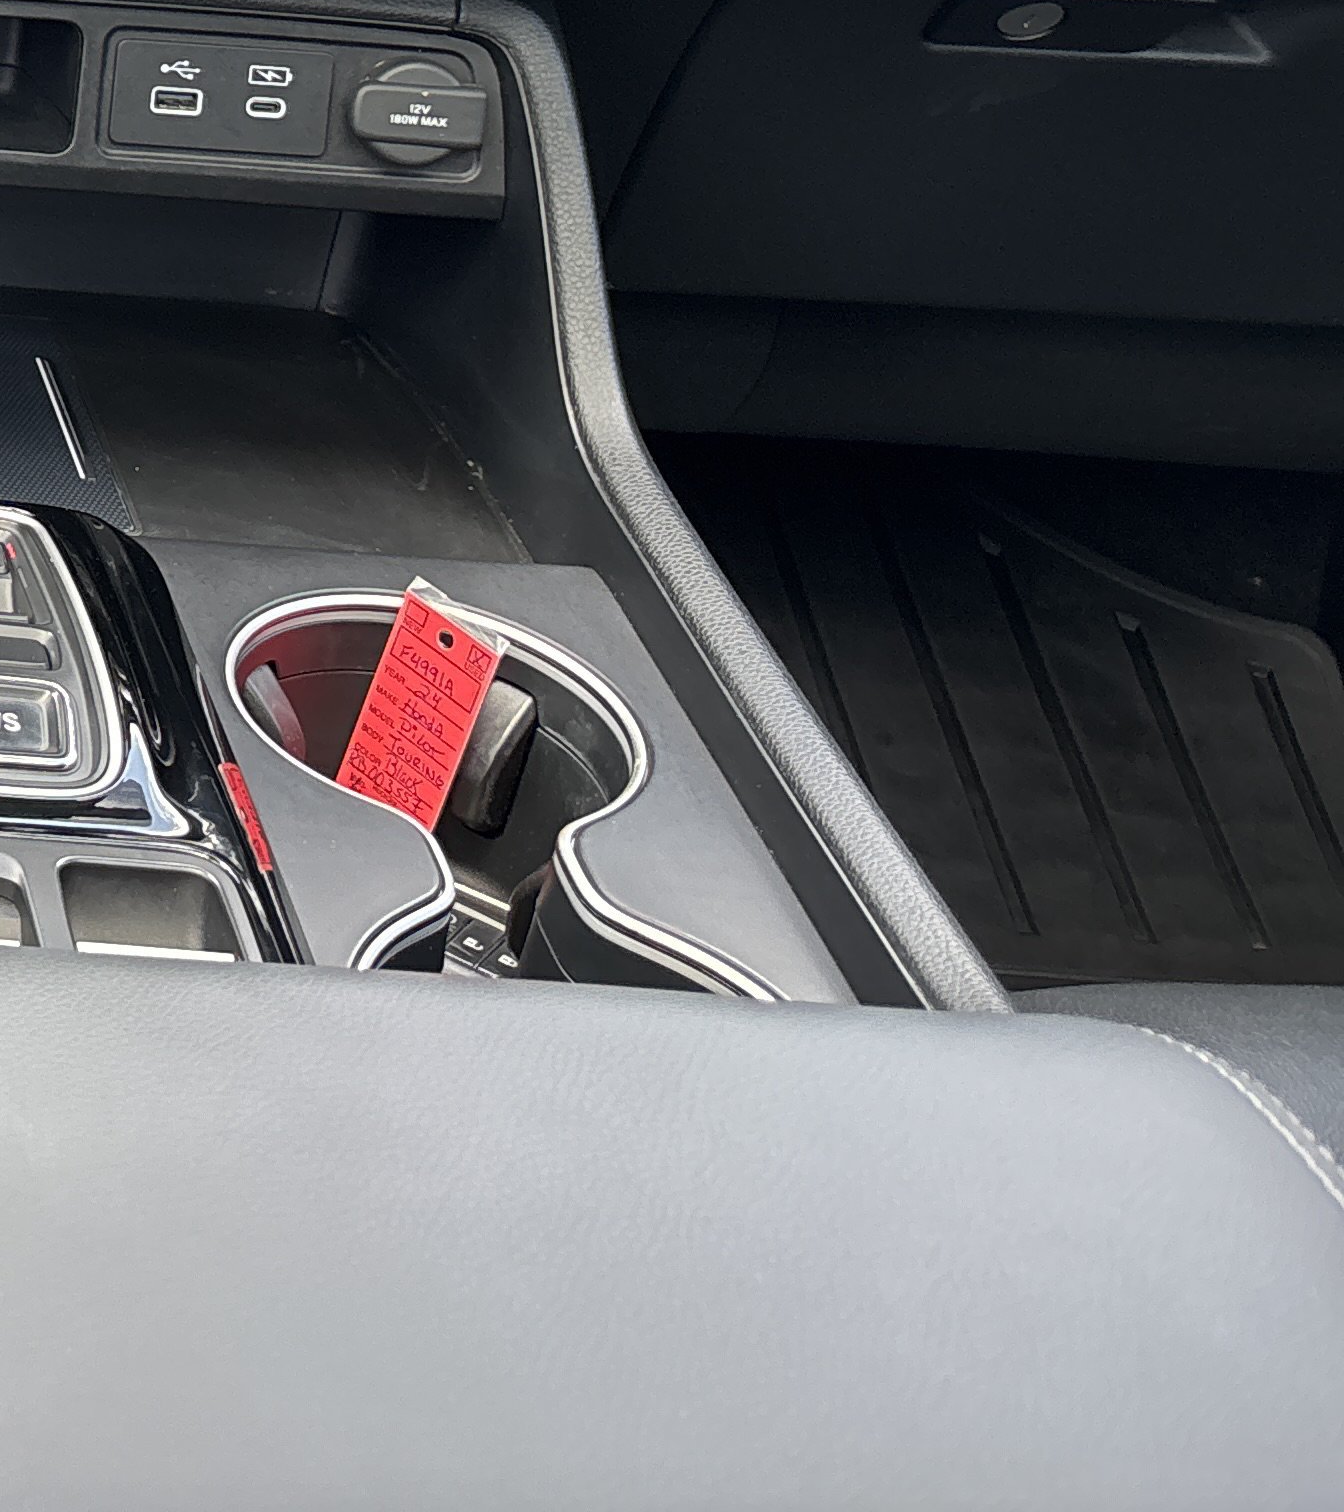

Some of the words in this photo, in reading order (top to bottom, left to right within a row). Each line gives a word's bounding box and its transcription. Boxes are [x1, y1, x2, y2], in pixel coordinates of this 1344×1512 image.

[409, 103, 431, 115] 12V
[420, 115, 448, 128] MAX
[399, 645, 453, 696] F4991A
[464, 662, 485, 681] USED
[376, 685, 399, 705] MAKE
[384, 665, 406, 686] YEAR
[413, 682, 441, 708] 24
[369, 703, 395, 729] MODEL
[361, 722, 384, 743] BODY
